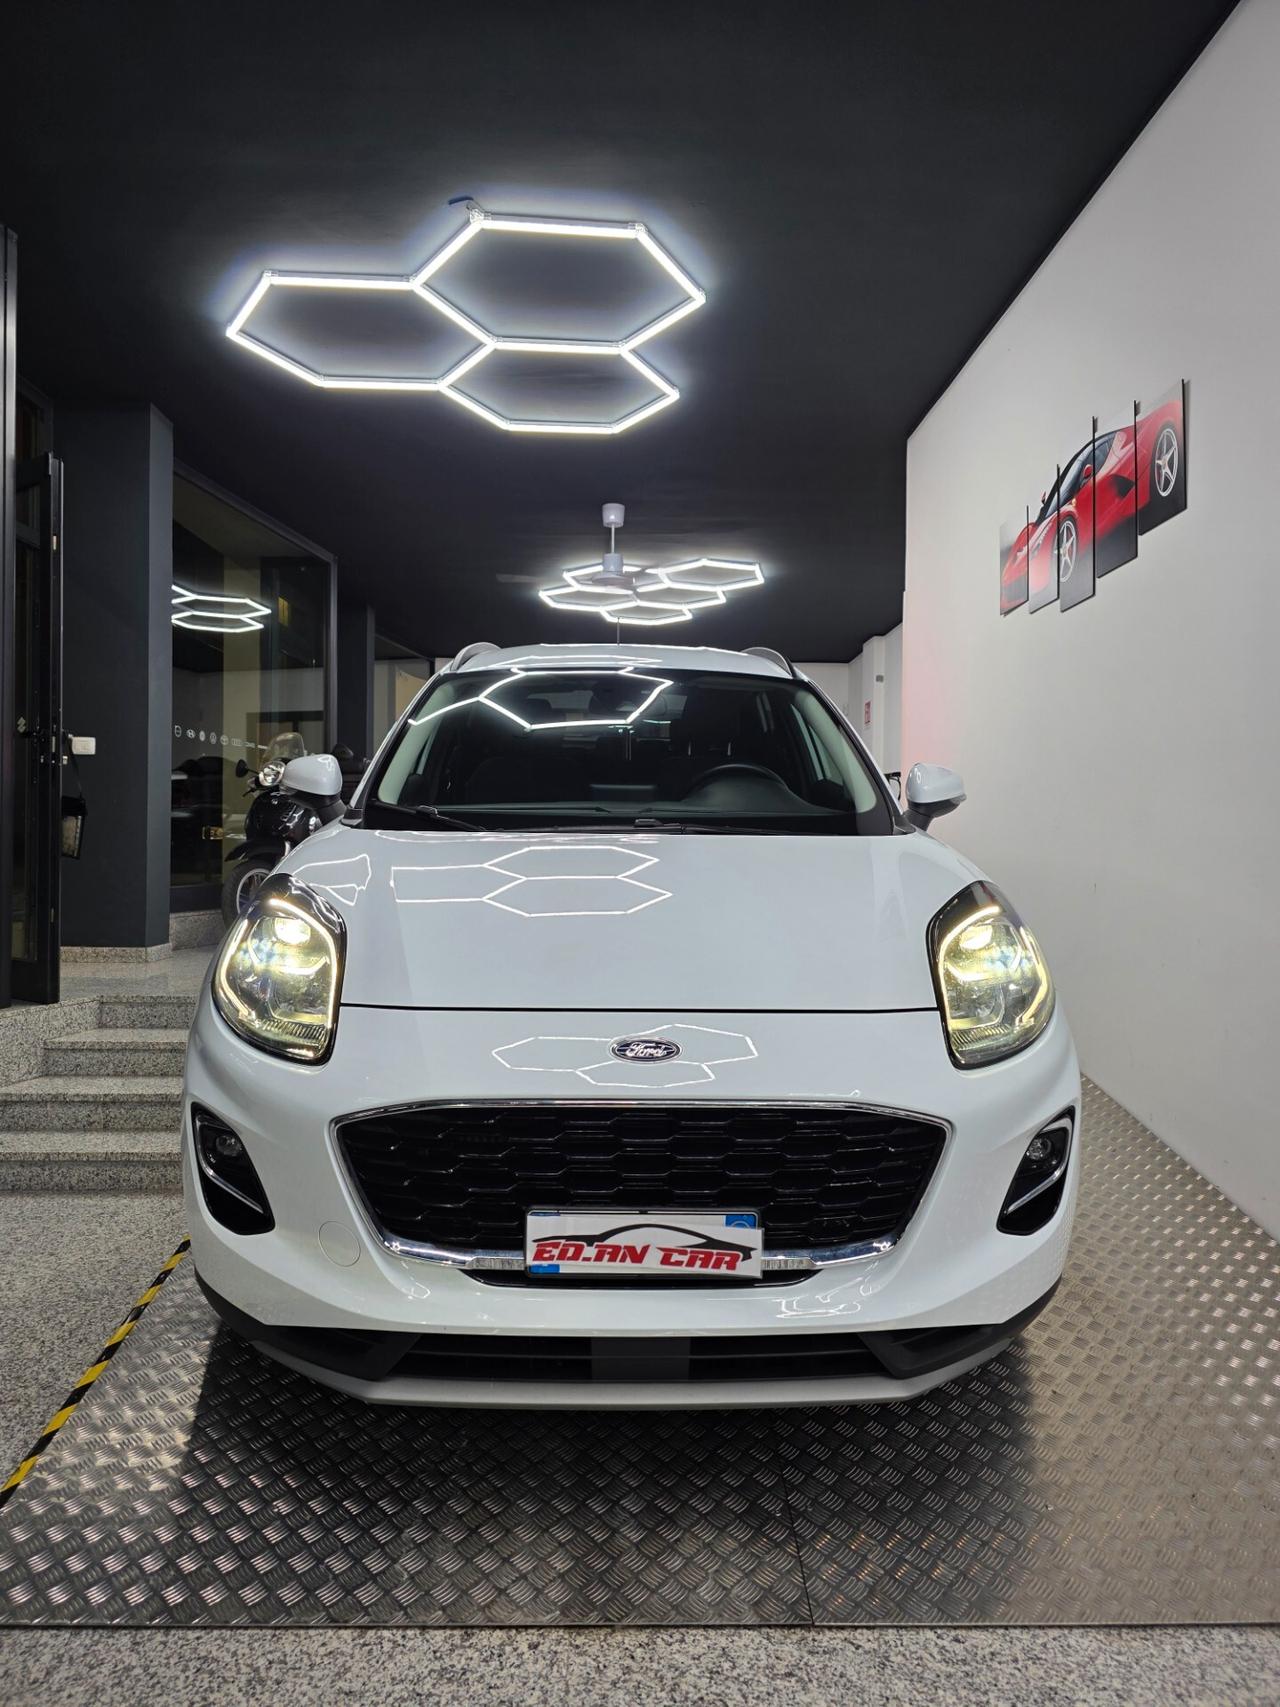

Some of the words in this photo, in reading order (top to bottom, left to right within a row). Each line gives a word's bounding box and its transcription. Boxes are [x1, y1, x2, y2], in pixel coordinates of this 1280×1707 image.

[625, 1042, 667, 1057] Ford
[532, 1241, 650, 1264] ED.AN
[657, 1246, 741, 1270] CAR
